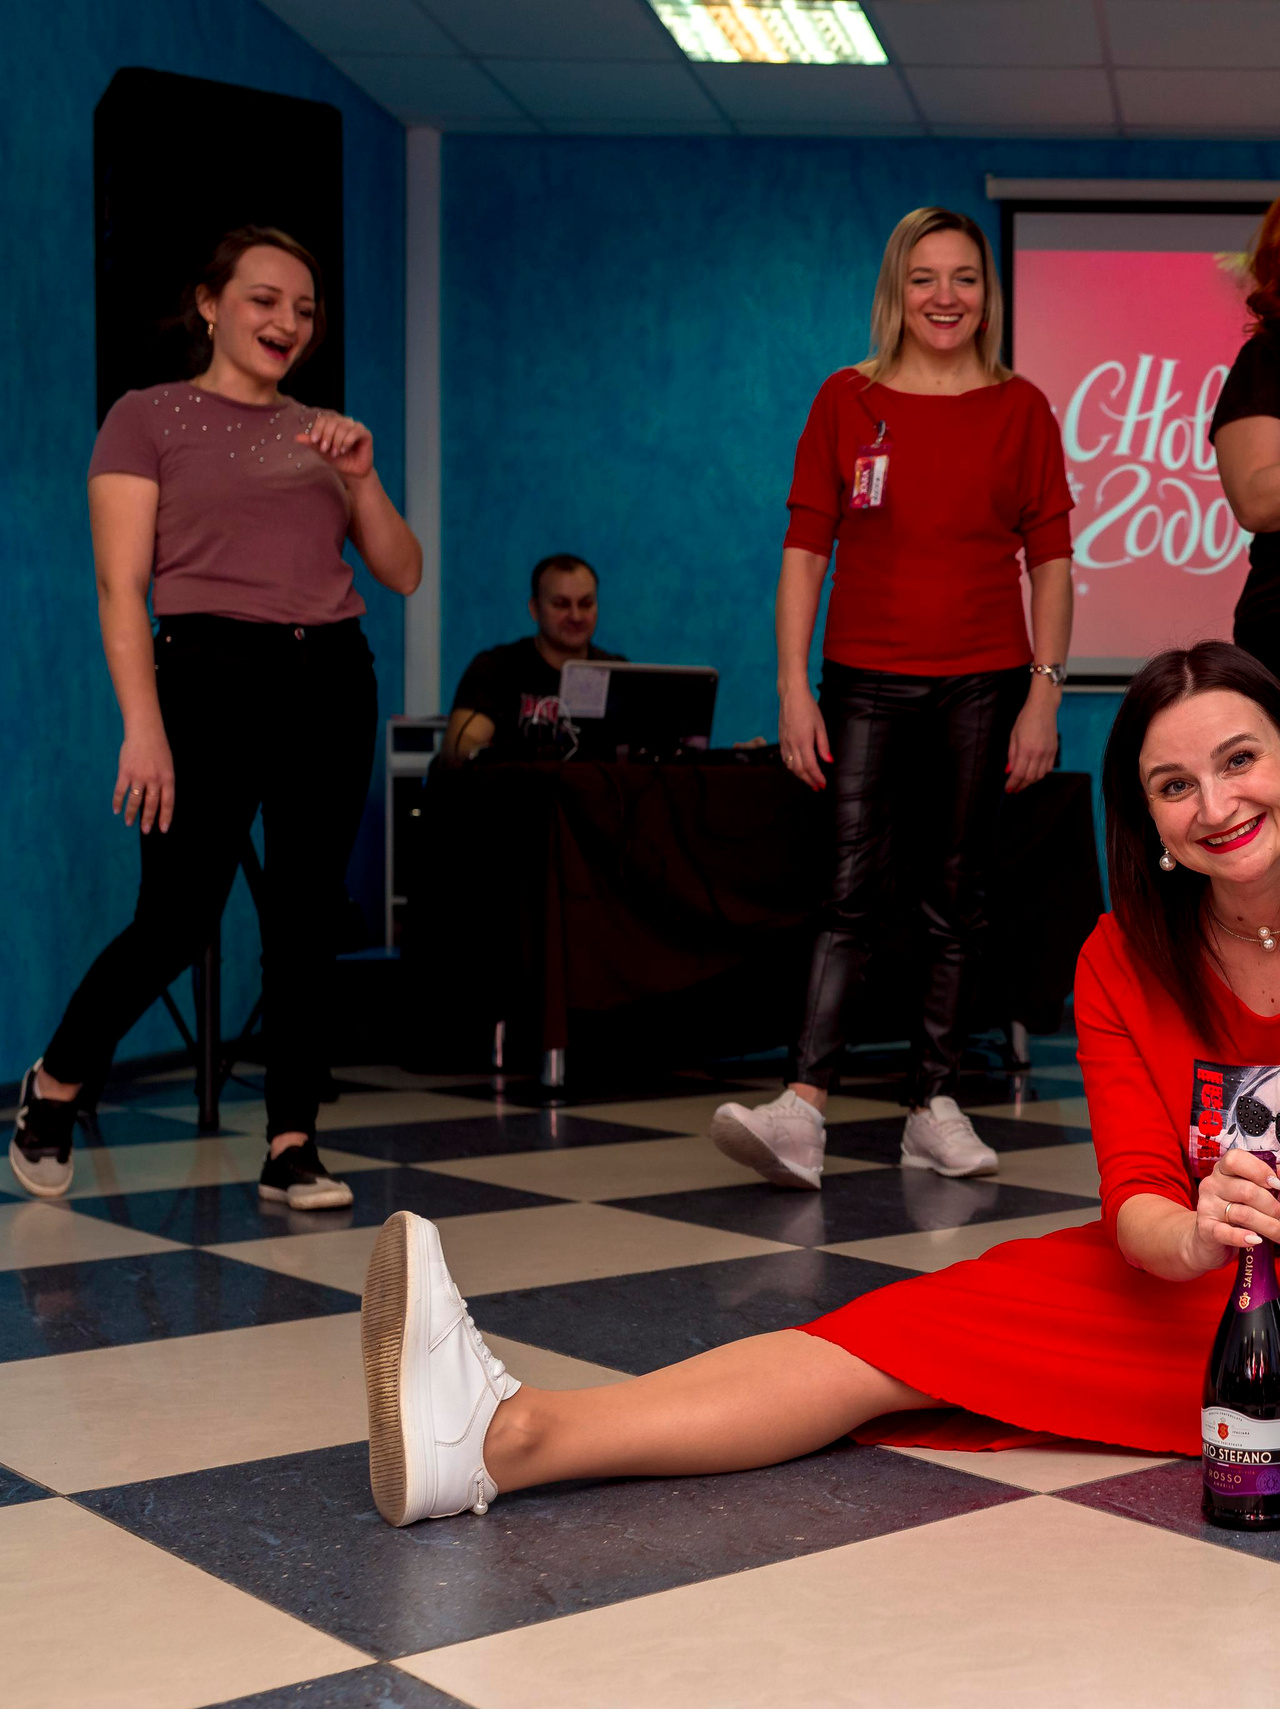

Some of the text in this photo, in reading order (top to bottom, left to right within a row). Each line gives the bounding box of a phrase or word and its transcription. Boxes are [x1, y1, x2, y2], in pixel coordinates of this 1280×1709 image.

[1100, 352, 1229, 481] Нов
[1197, 1068, 1223, 1170] veal
[1242, 1254, 1254, 1288] SANTO
[1218, 1448, 1272, 1464] STEFANO
[1208, 1468, 1242, 1484] ROSSO
